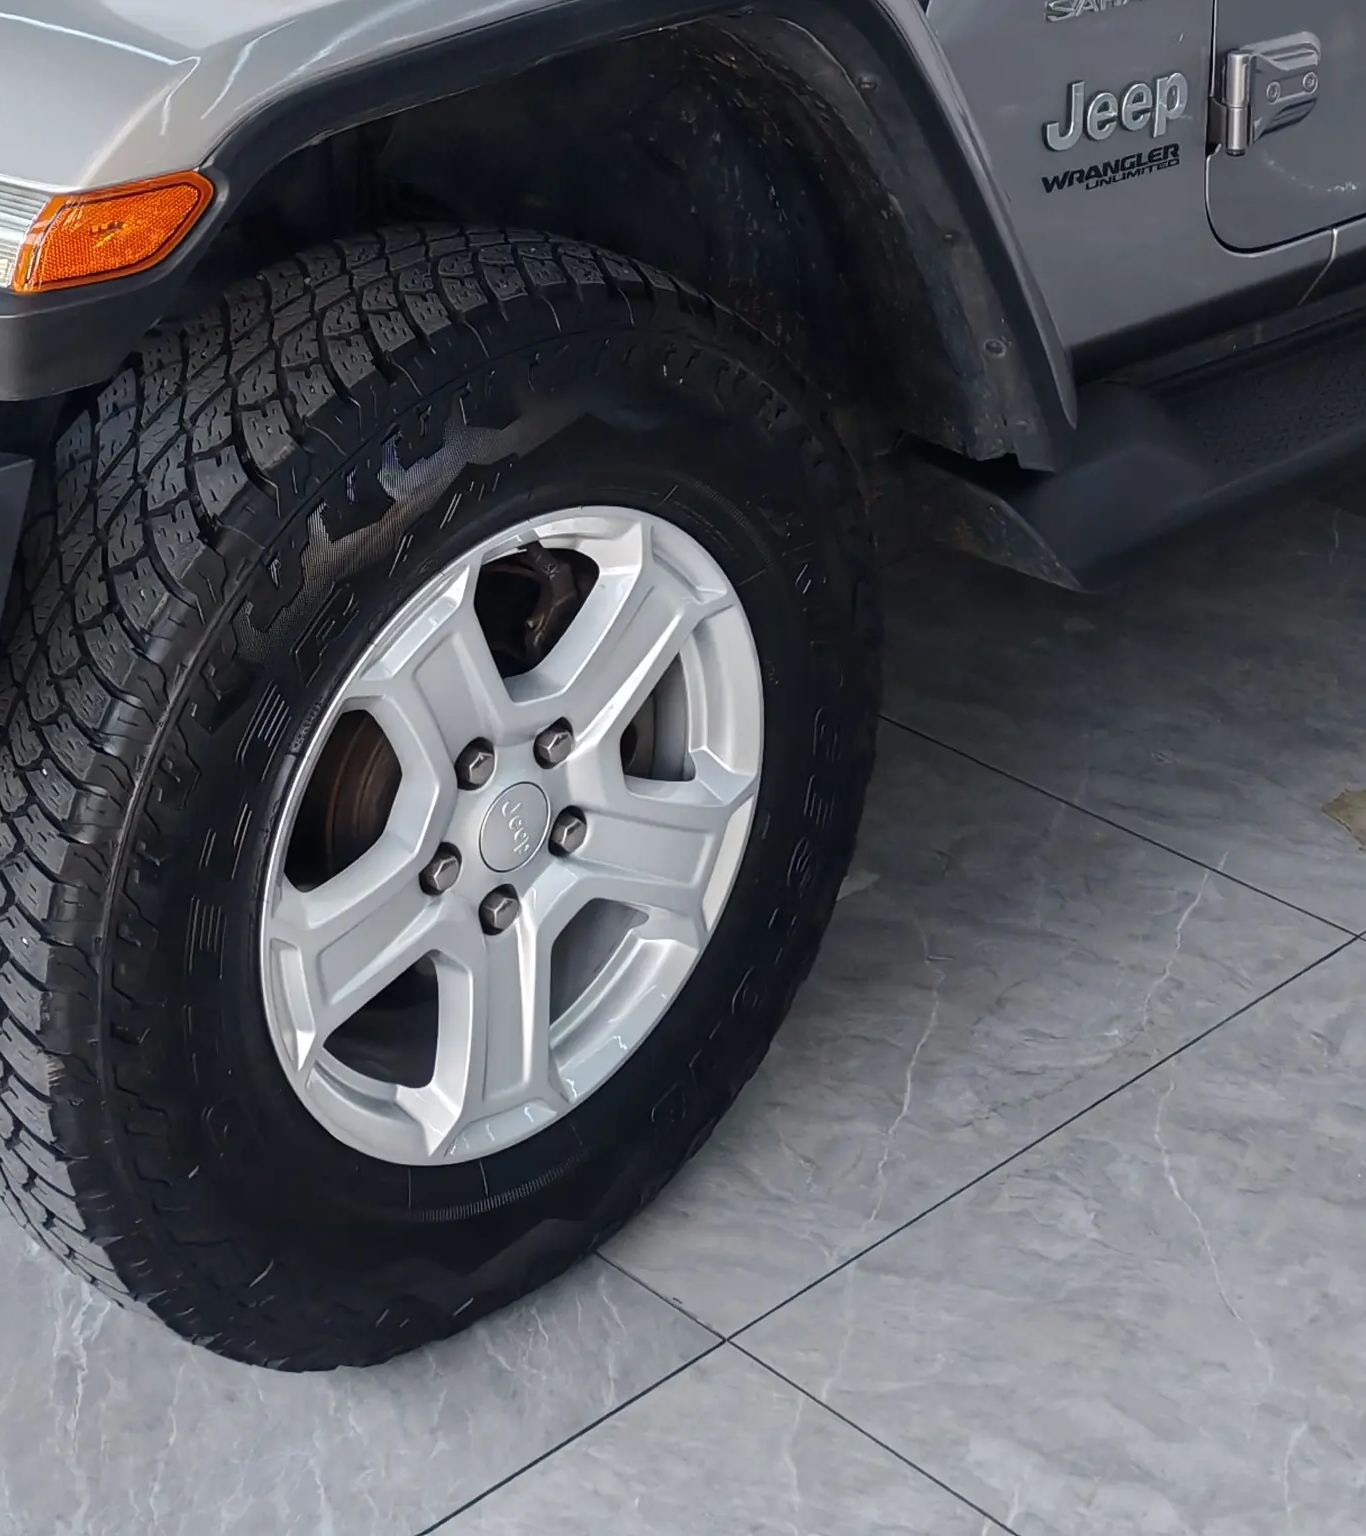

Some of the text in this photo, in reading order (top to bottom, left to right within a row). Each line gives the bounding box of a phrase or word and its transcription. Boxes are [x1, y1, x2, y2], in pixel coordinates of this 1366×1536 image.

[1043, 71, 1189, 152] Jeep
[1041, 142, 1181, 194] WRANGLER
[1085, 157, 1181, 191] UNLIMITED
